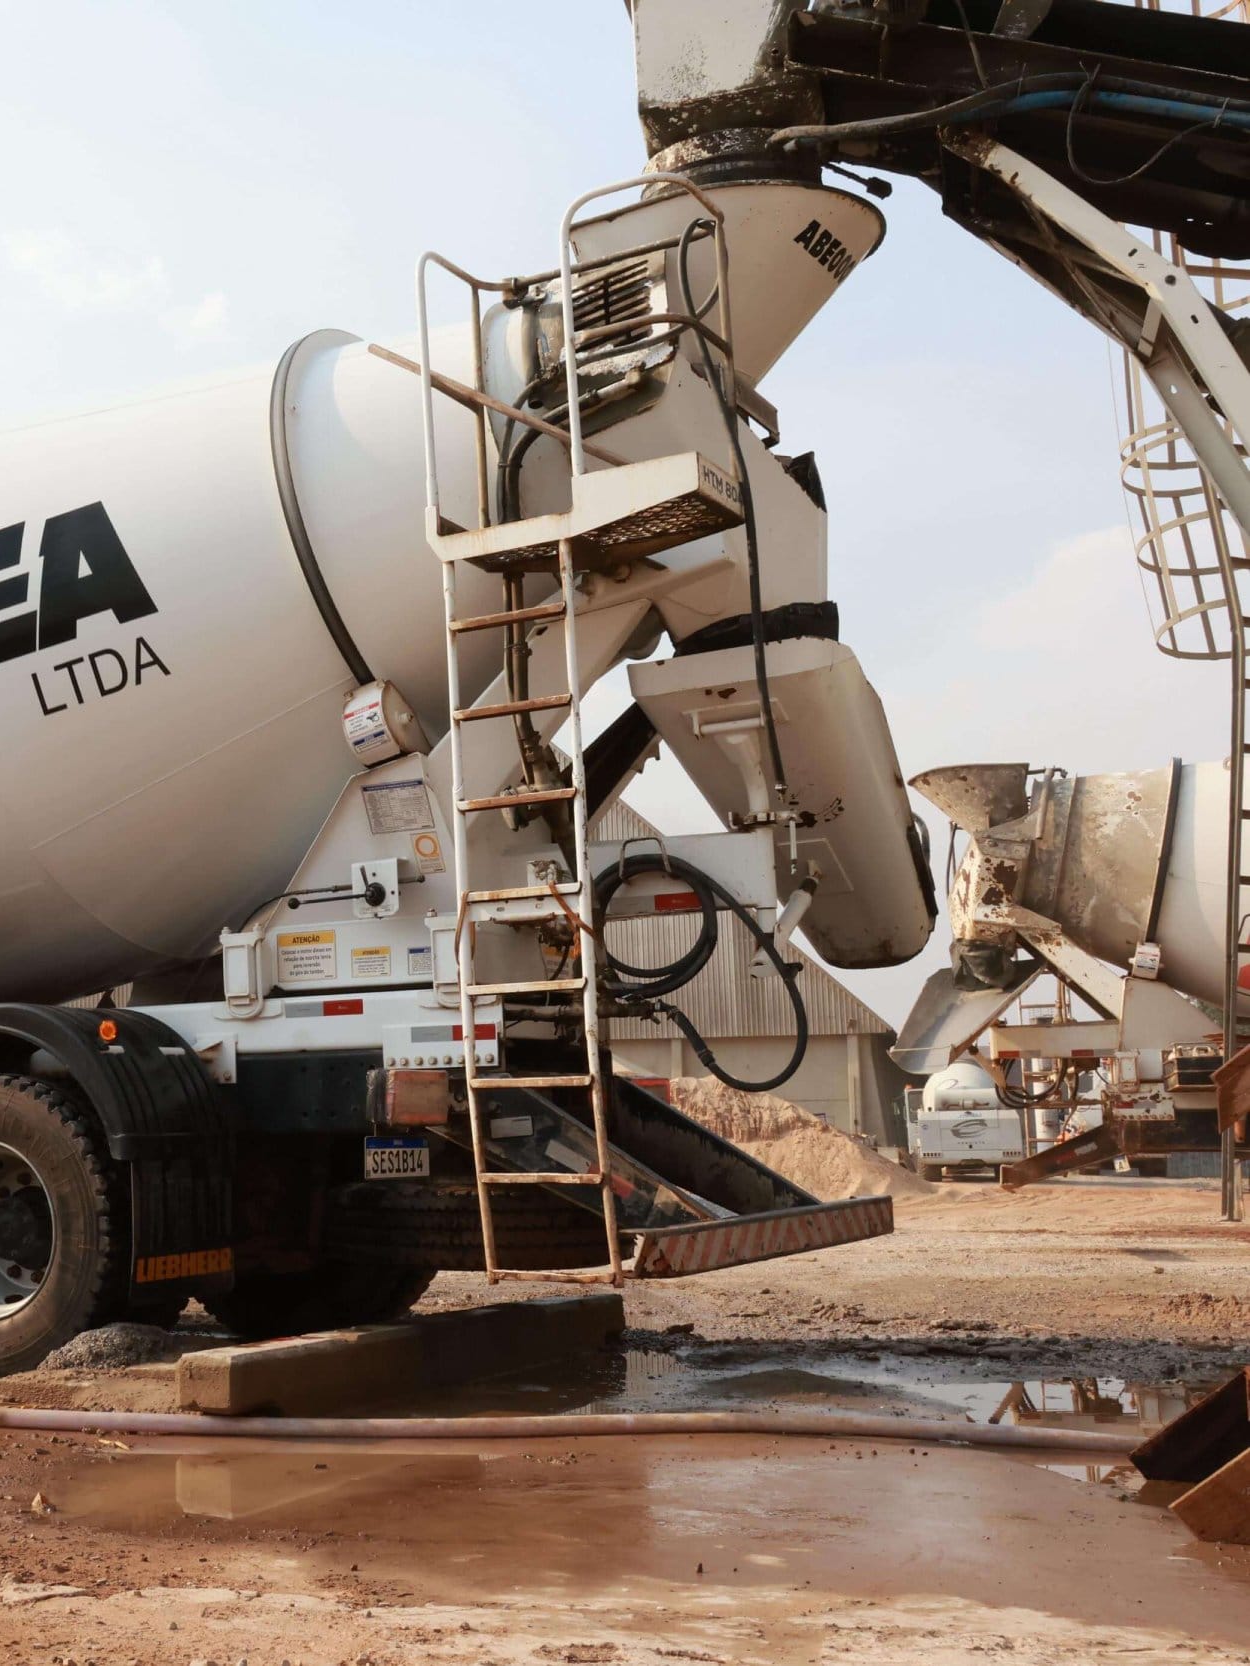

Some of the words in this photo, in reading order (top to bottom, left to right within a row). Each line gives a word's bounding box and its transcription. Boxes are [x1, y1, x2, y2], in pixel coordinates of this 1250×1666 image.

[31, 637, 171, 716] LTDA
[292, 934, 320, 944] ATENÇÃO
[372, 1150, 423, 1174] SES1B14
[136, 1248, 231, 1284] LIEBHERR
